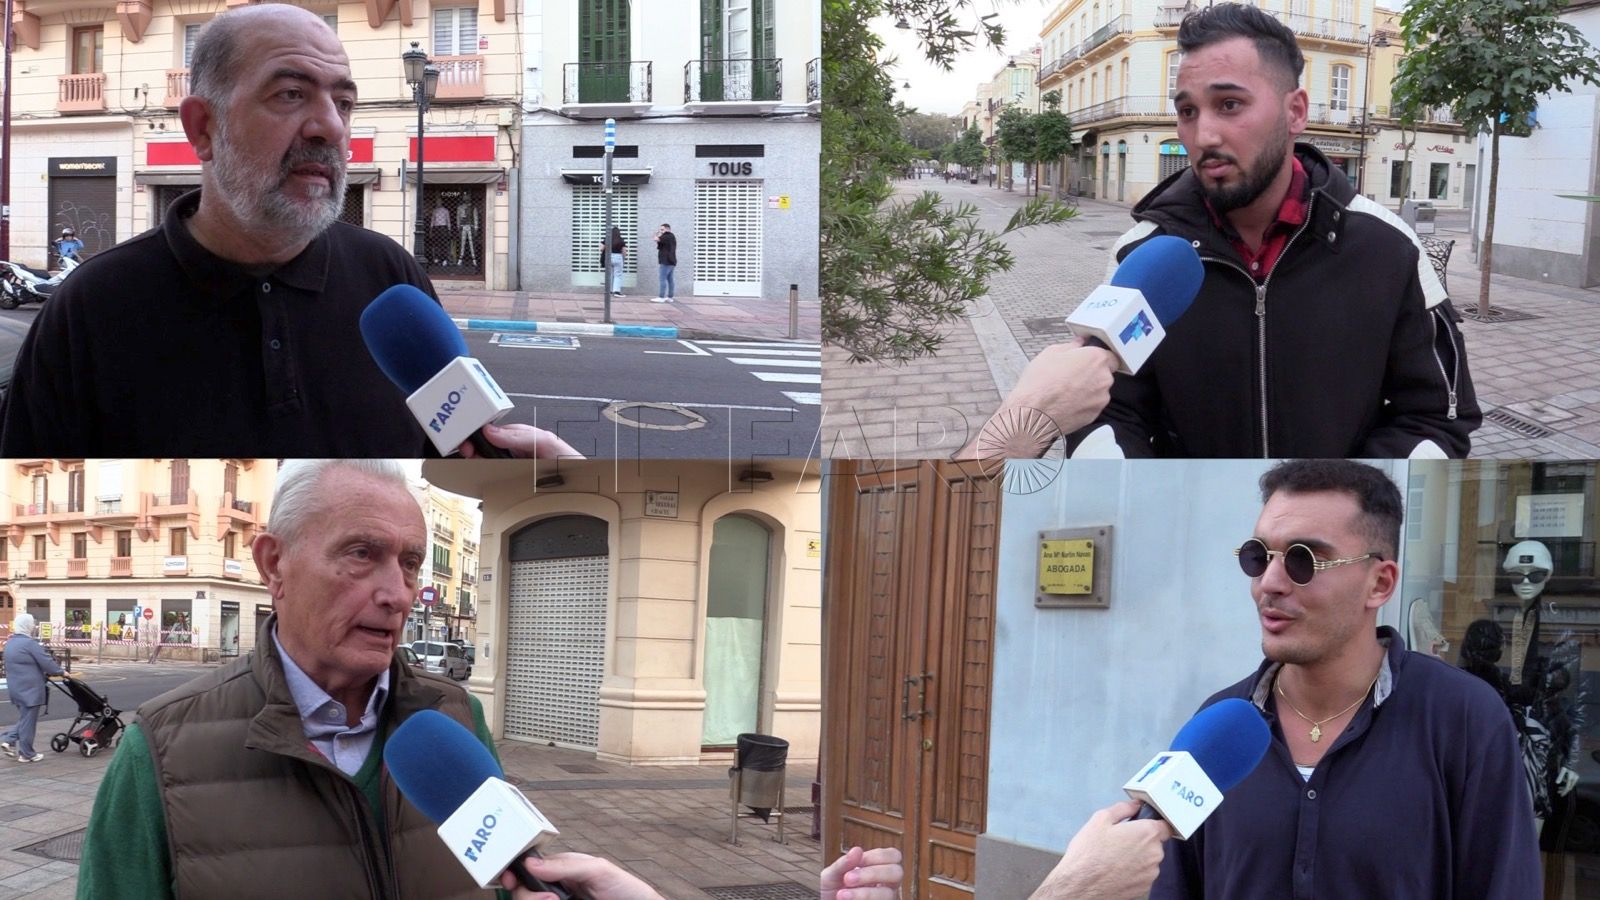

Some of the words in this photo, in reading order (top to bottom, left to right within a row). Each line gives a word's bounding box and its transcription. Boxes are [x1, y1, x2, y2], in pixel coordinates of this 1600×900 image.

[709, 161, 753, 176] TOUS
[428, 391, 461, 433] FARO
[1046, 564, 1086, 573] ABOGADA
[1171, 780, 1205, 807] FARO
[464, 814, 497, 862] FARO
